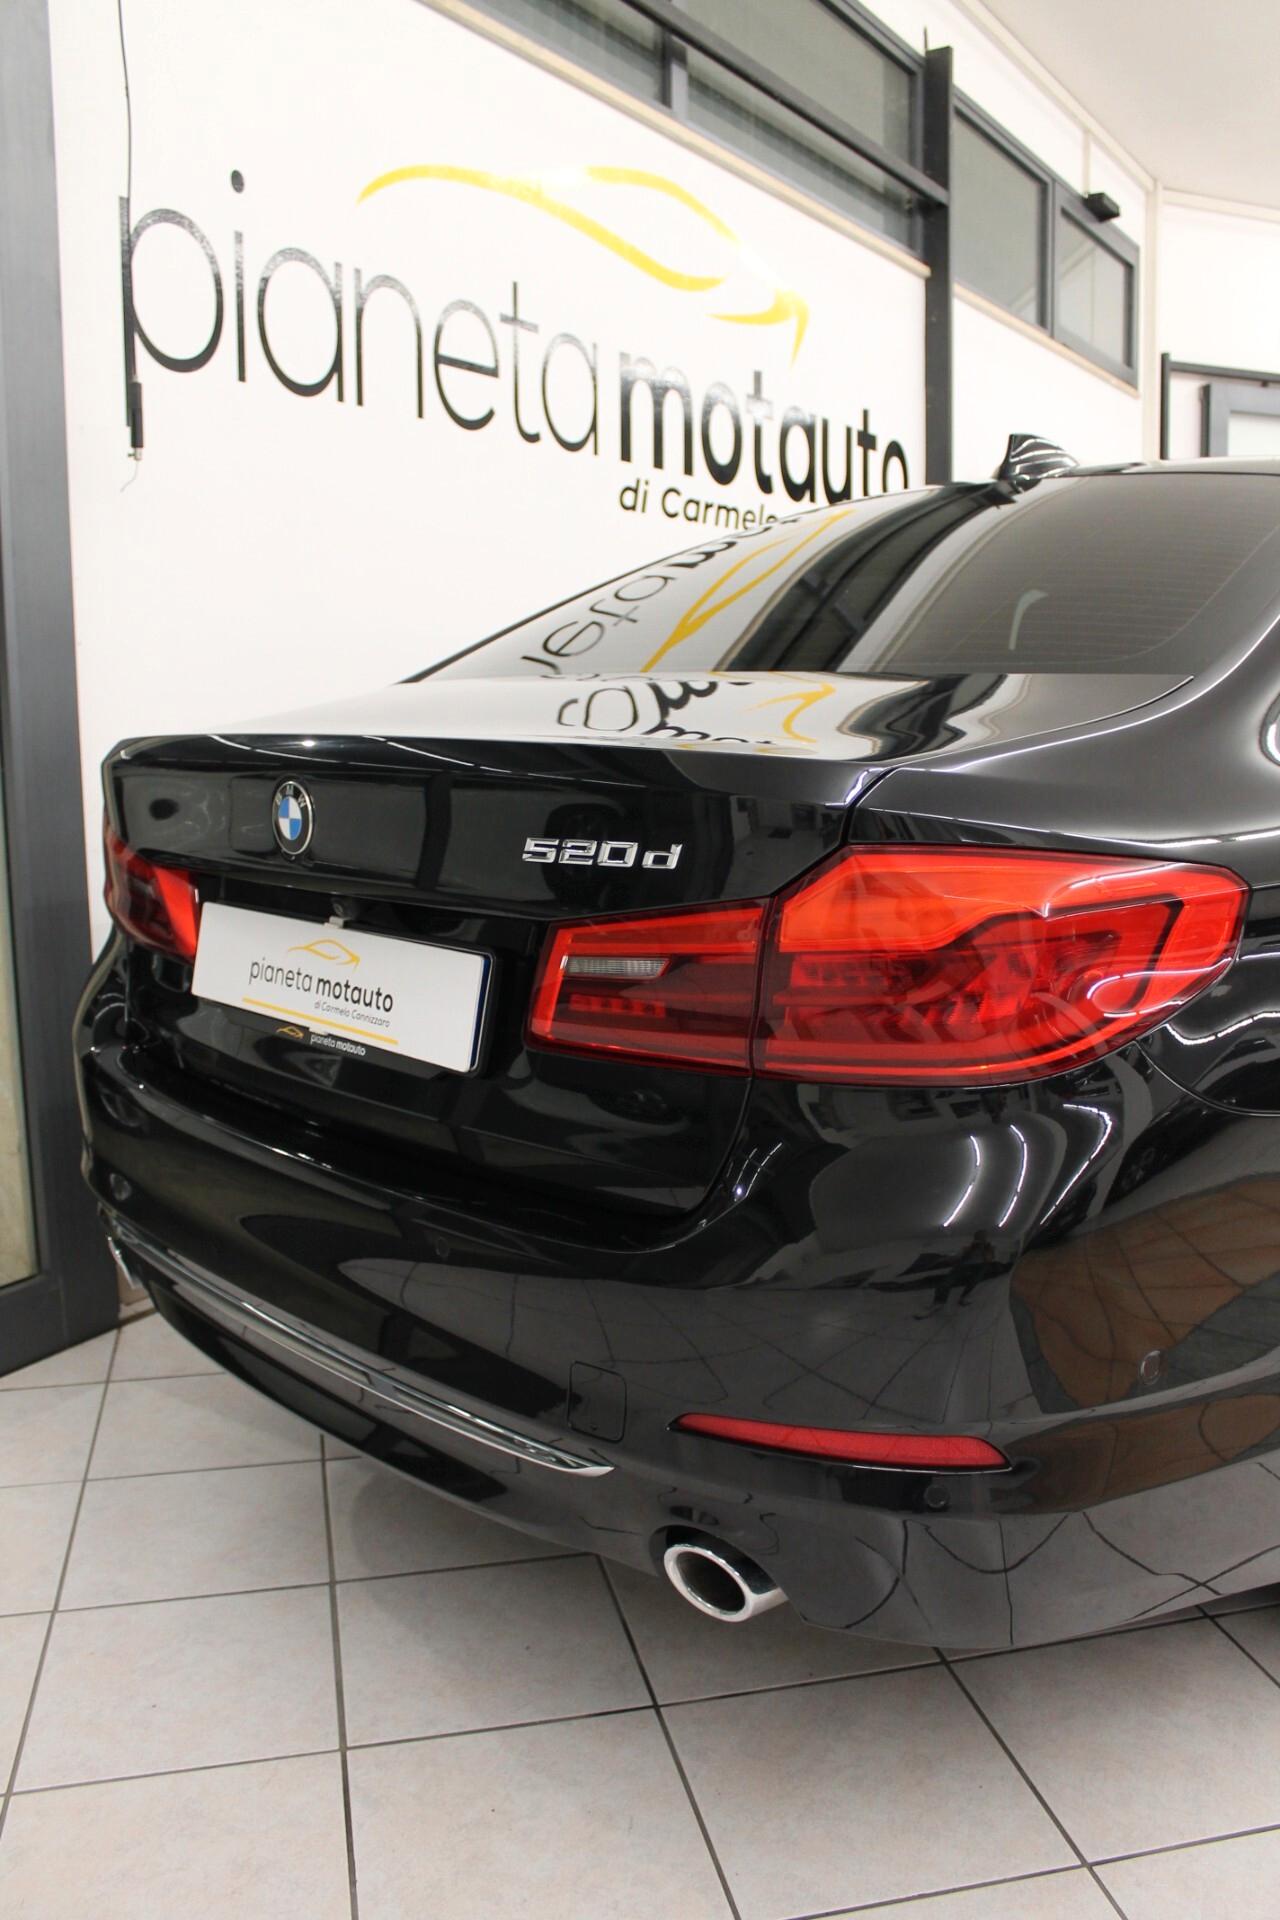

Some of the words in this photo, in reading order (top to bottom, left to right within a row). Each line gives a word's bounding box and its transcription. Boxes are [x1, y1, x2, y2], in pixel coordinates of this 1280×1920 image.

[118, 169, 599, 456] pianeta
[619, 351, 908, 504] motauto
[619, 478, 648, 512] di
[522, 836, 683, 870] 520d
[249, 957, 313, 993] pianeta
[315, 977, 393, 1013] motauto
[314, 1000, 322, 1010] di
[321, 1002, 350, 1018] Carmelo
[351, 1009, 390, 1028] Cannizzaro
[310, 1033, 336, 1049] pianeta
[336, 1039, 367, 1057] motauto
